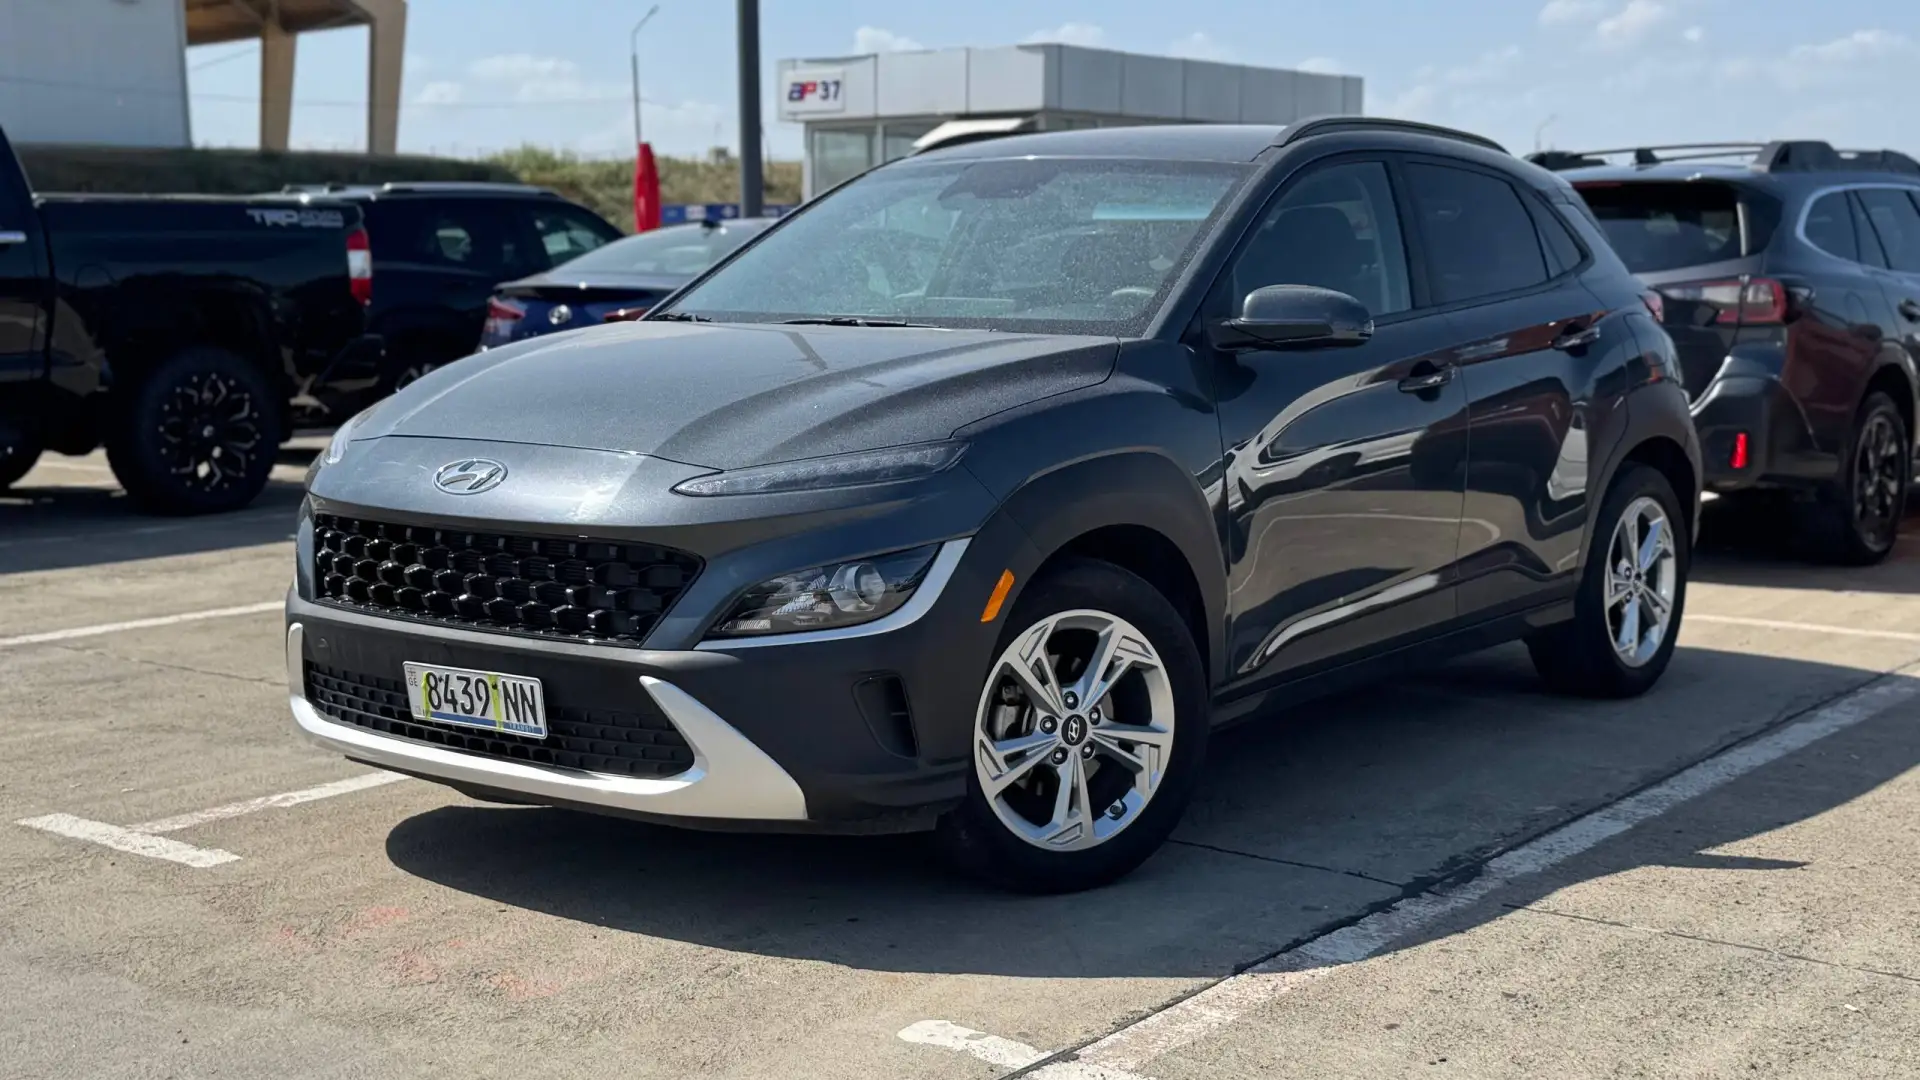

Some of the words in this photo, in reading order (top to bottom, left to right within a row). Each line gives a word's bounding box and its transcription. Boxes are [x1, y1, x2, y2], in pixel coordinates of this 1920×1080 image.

[819, 79, 841, 101] 37
[425, 671, 490, 717] 8439
[501, 680, 539, 726] NN
